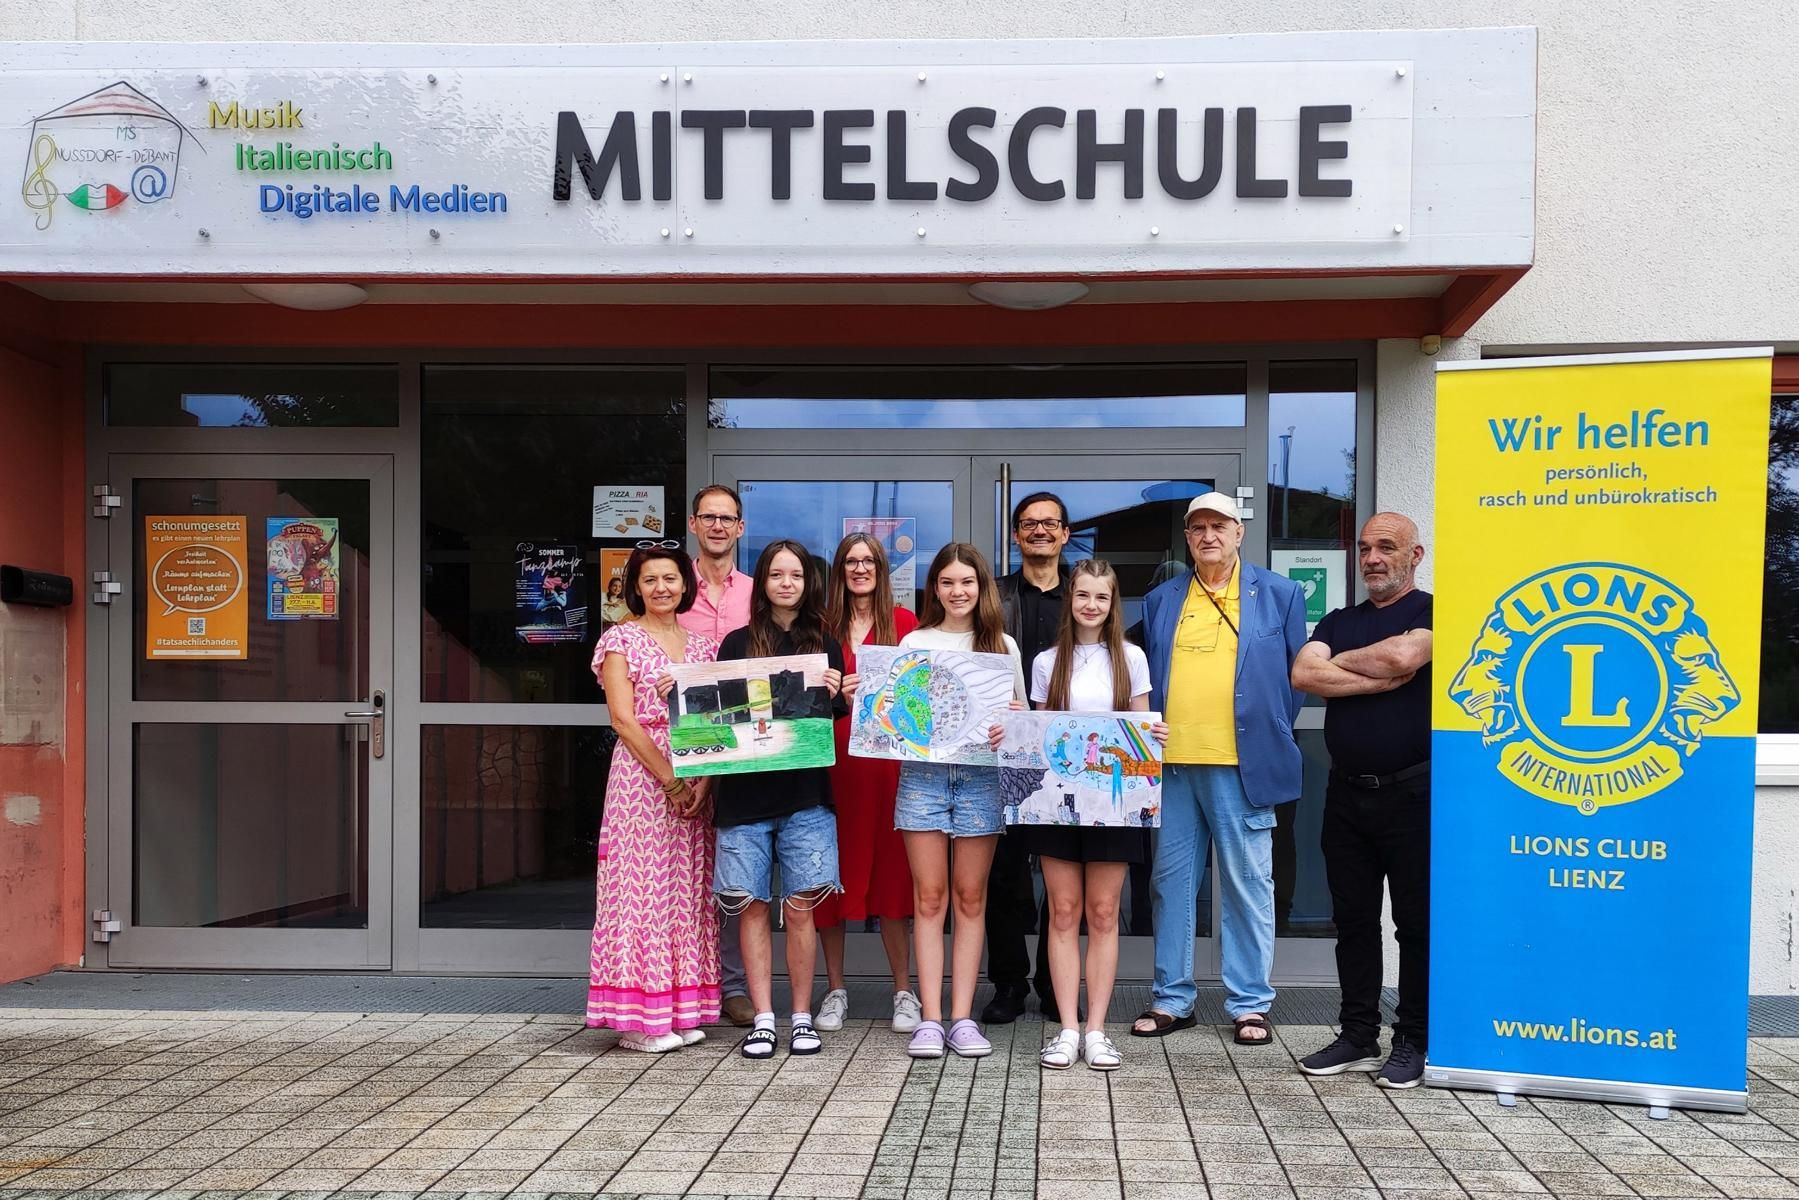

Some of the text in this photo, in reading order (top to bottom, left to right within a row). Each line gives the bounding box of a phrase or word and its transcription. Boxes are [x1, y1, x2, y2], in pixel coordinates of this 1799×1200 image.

[208, 101, 303, 130] Musik
[116, 125, 137, 140] MS
[235, 141, 393, 172] Italienisch
[553, 103, 1354, 203] MITTELSCHULE
[259, 184, 508, 220] Digitale Medien
[1488, 408, 1710, 453] Wir helfen
[1545, 461, 1648, 485] persönlich,
[609, 490, 630, 498] PIZZA
[1478, 486, 1718, 507] rasch und unbürokratisch
[152, 519, 241, 532] schonumgesetzt
[206, 584, 227, 592] statt
[1511, 571, 1678, 628] LIONS
[156, 638, 239, 647] #tatsaechlichanders
[1560, 643, 1631, 728] L
[1509, 748, 1671, 799] INTERNATIONAL
[1509, 834, 1669, 861] LIONS CLUB
[1548, 867, 1626, 891] LIENZ
[747, 1030, 777, 1042] VANS
[792, 1027, 819, 1037] FILA
[1492, 1017, 1678, 1051] www.lions.at
